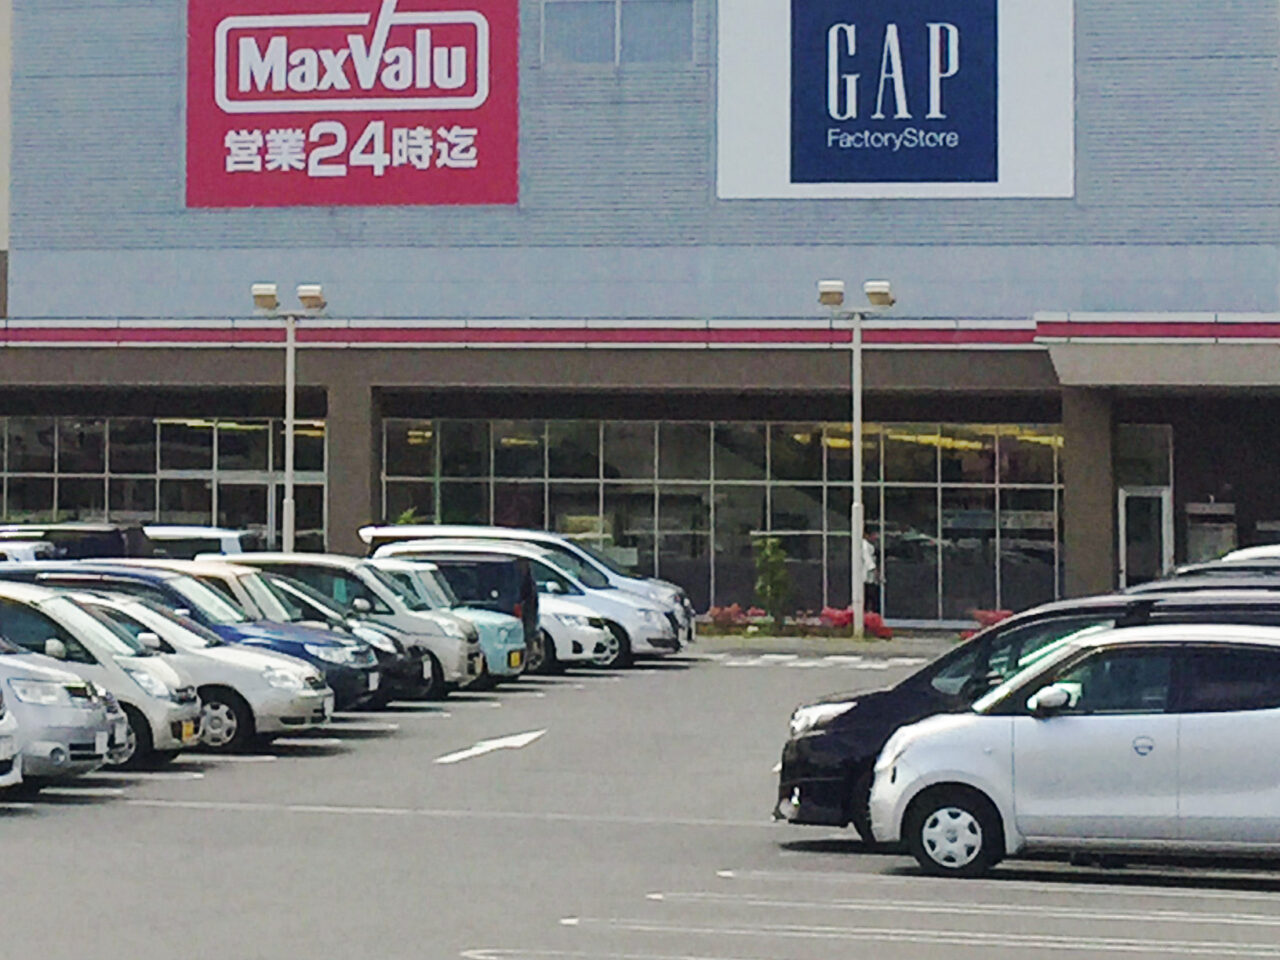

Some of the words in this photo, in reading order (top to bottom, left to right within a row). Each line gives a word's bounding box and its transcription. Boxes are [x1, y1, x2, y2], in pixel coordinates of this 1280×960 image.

[827, 23, 960, 120] GAP
[224, 120, 478, 177] 営業24時迄
